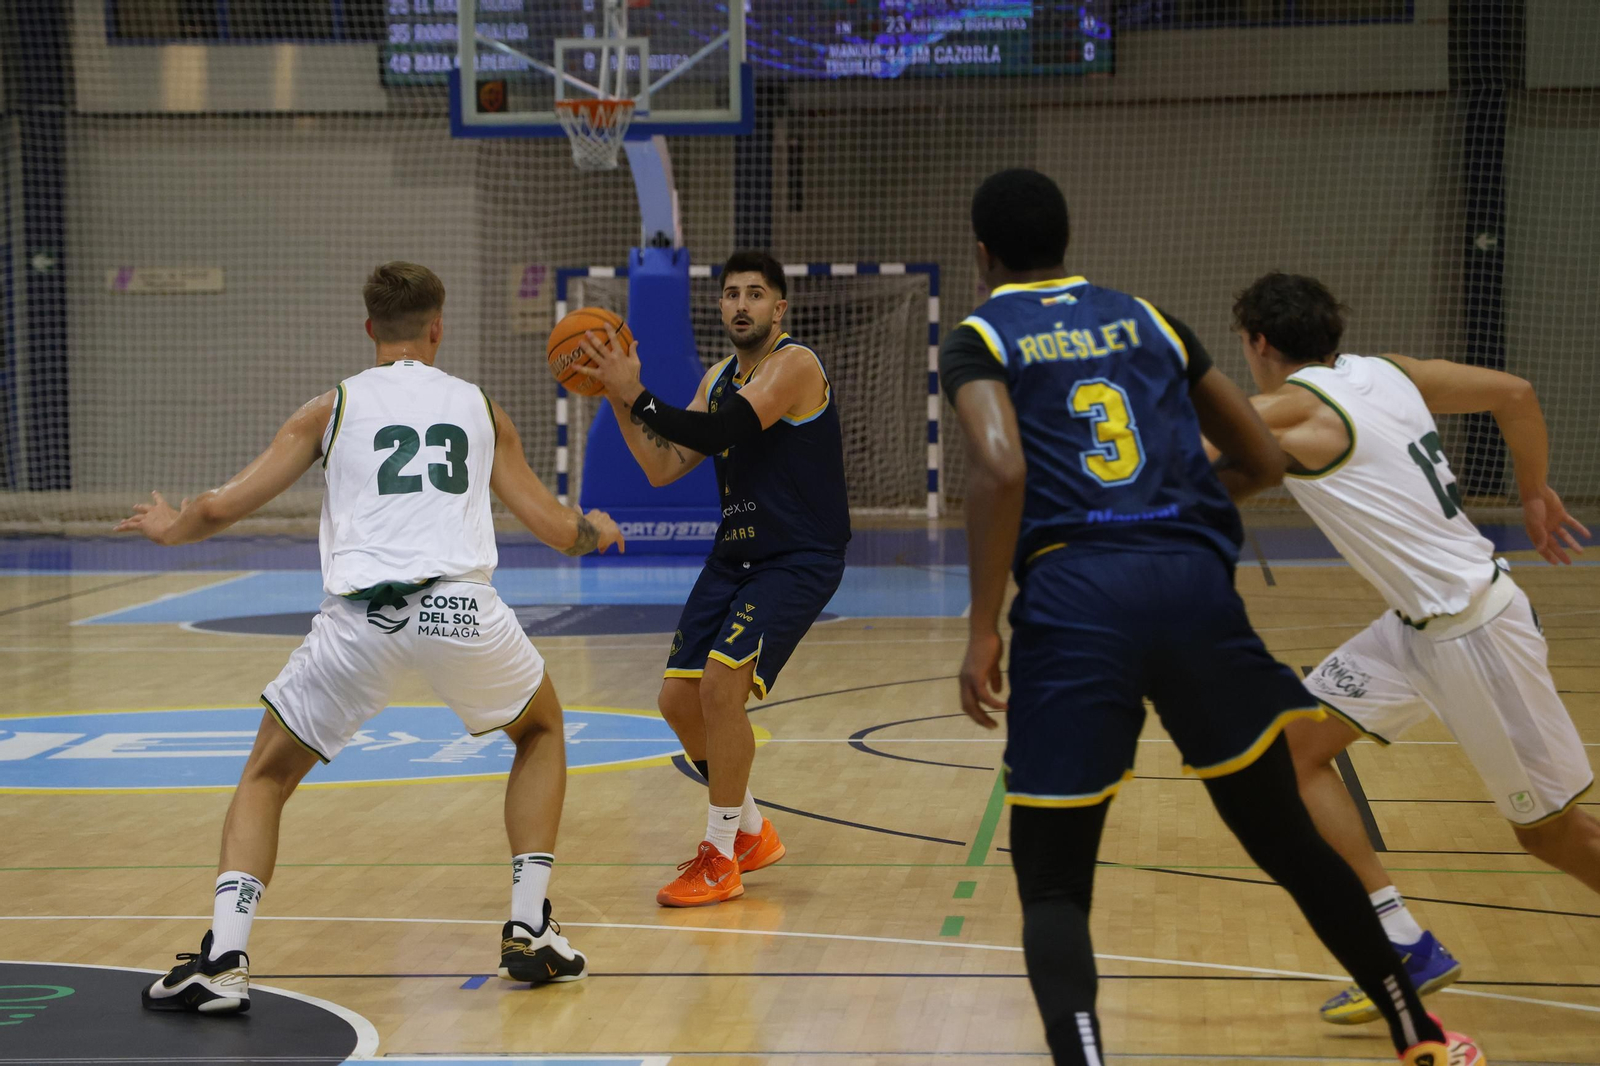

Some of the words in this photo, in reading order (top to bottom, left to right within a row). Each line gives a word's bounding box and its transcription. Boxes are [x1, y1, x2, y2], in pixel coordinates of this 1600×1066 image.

[886, 16, 906, 33] 23
[933, 44, 1001, 64] CAZORLA
[1083, 41, 1095, 61] 0
[1017, 319, 1141, 365] ROÉSLEY
[1067, 377, 1147, 488] 3
[374, 423, 469, 495] 23
[722, 499, 757, 518] ex.io
[420, 595, 479, 611] COSTA
[419, 611, 449, 623] DEL
[453, 613, 479, 625] SOL
[736, 611, 754, 622] vive
[418, 624, 480, 637] MÁLAGA
[724, 622, 746, 645] 7
